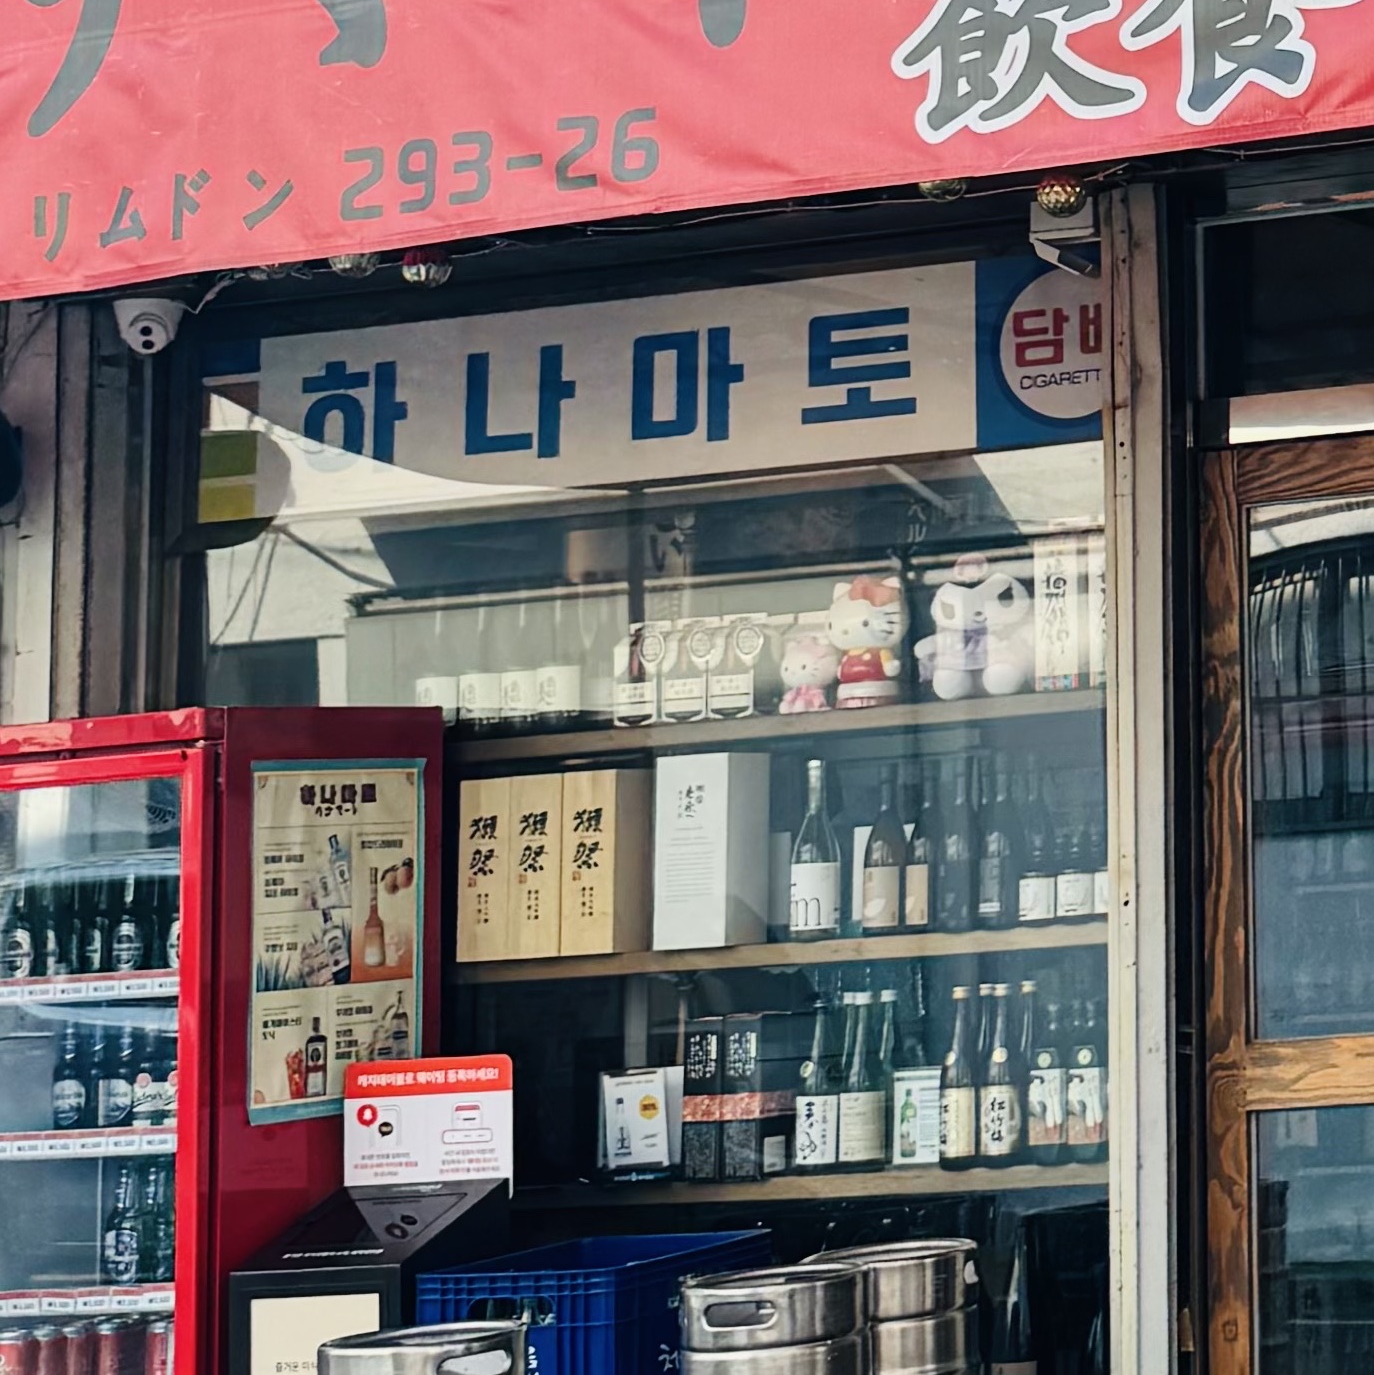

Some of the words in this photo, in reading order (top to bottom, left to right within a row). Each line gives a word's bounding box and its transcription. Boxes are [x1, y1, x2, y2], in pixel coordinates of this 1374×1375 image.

[338, 106, 661, 222] 293-26
[300, 306, 918, 474] 하나마토
[1020, 368, 1102, 390] CIGARETT
